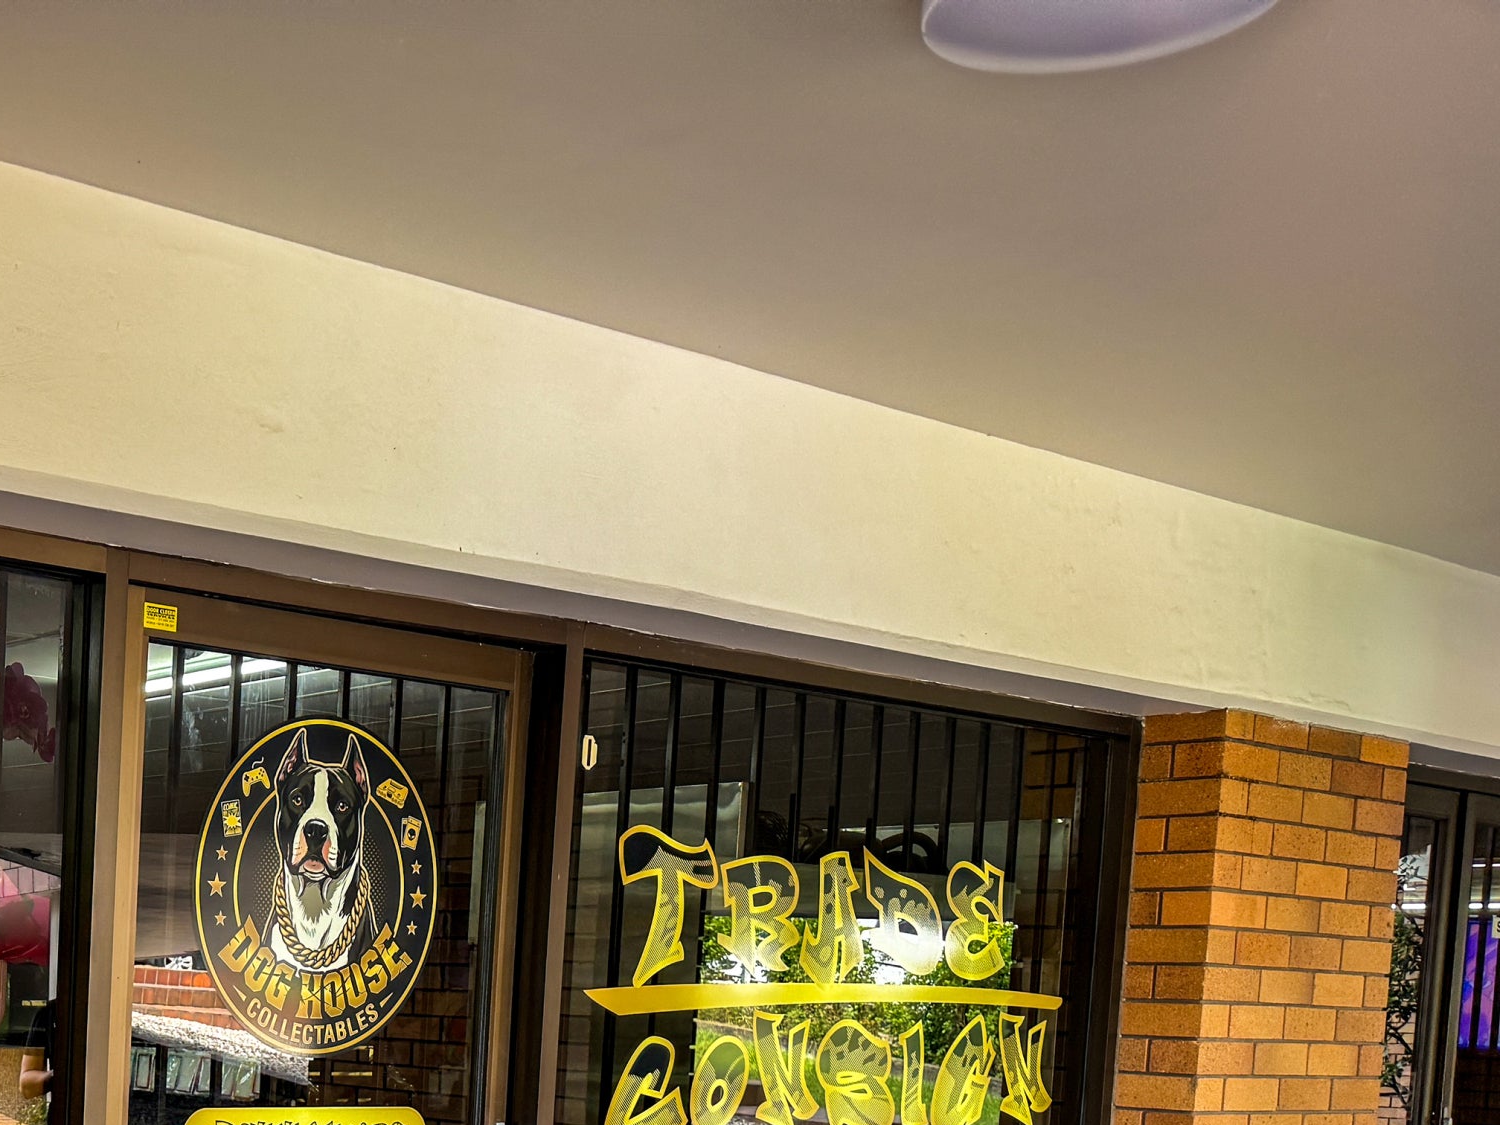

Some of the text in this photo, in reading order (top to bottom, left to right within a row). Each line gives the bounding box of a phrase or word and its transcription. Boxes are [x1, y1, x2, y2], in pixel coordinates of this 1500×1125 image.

[618, 824, 1005, 990] TRADE
[217, 914, 414, 1020] DOG HOUSE
[246, 1000, 380, 1045] COLLECTABLES
